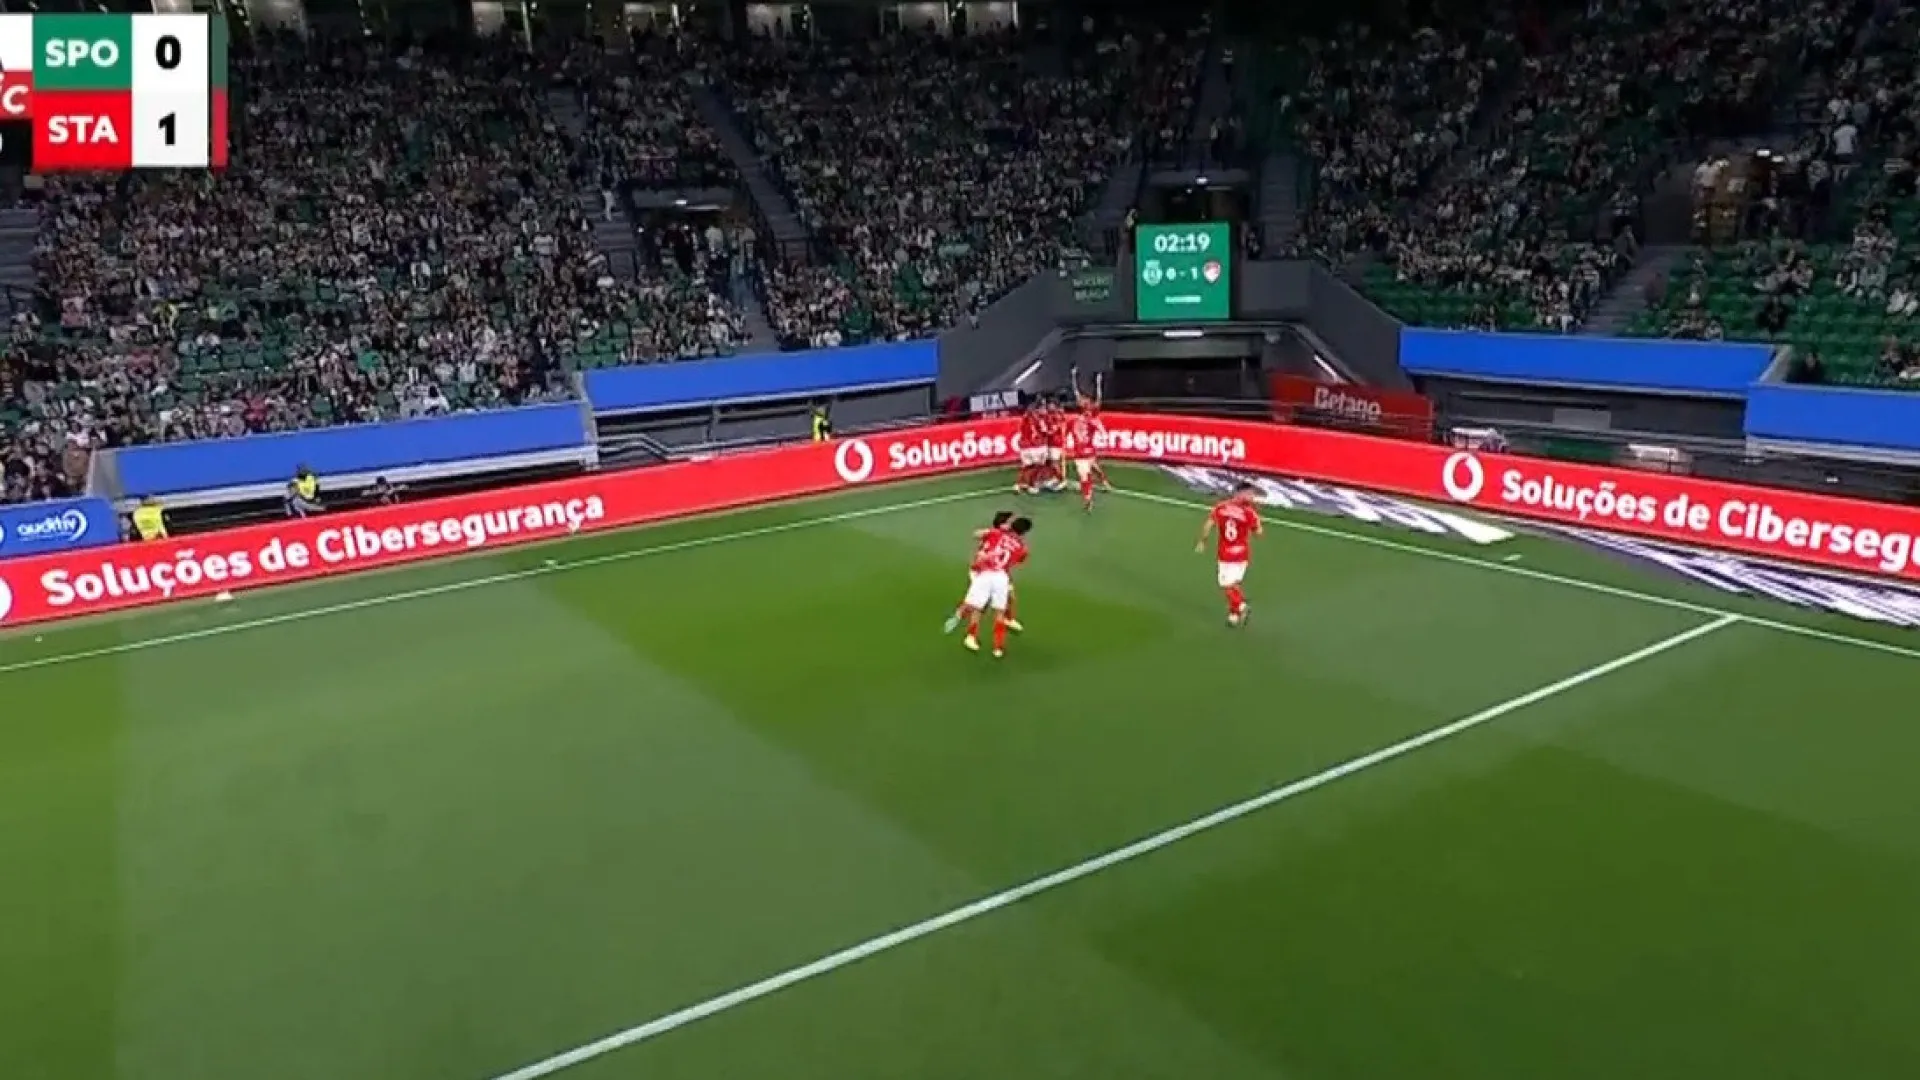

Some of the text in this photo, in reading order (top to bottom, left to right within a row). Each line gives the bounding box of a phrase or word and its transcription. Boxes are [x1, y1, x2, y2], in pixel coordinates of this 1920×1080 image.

[1154, 233, 1211, 253] 02:19
[1190, 266, 1198, 280] 1
[888, 431, 1007, 469] Soluções
[1501, 468, 1658, 522] Soluções
[1663, 493, 1711, 531] de
[40, 495, 605, 606] Soluções de Cibersegurança
